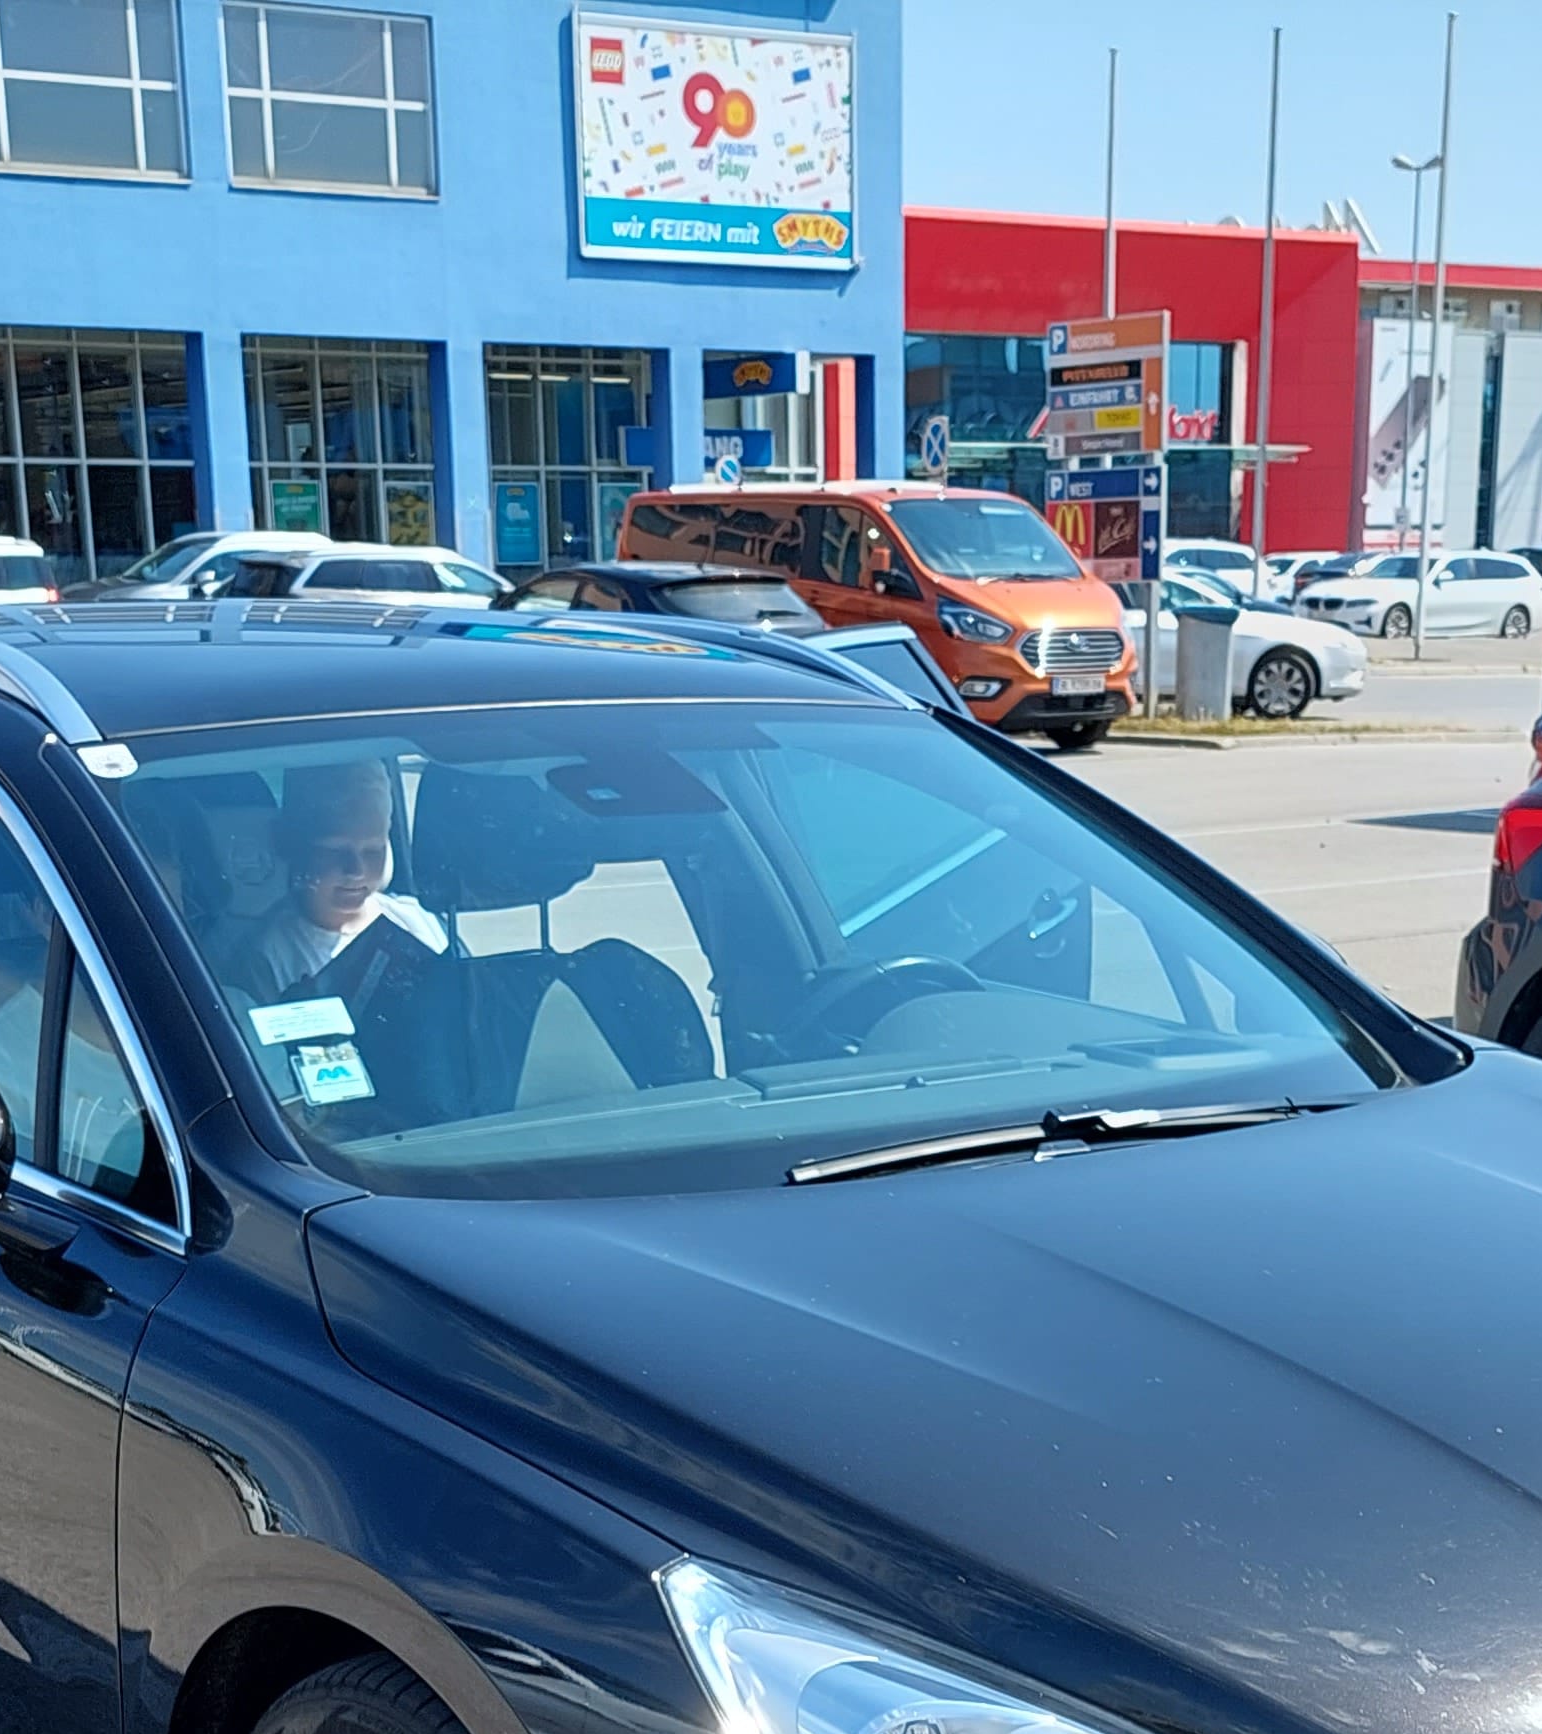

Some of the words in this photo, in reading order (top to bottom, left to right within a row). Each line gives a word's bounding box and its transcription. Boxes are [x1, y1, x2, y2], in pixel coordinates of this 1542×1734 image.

[592, 50, 623, 72] LEGO
[683, 72, 755, 148] 90
[717, 159, 751, 181] play
[612, 215, 645, 239] wir
[650, 218, 722, 242] FEIERN
[726, 222, 760, 245] mit
[776, 214, 847, 248] SMYTHS
